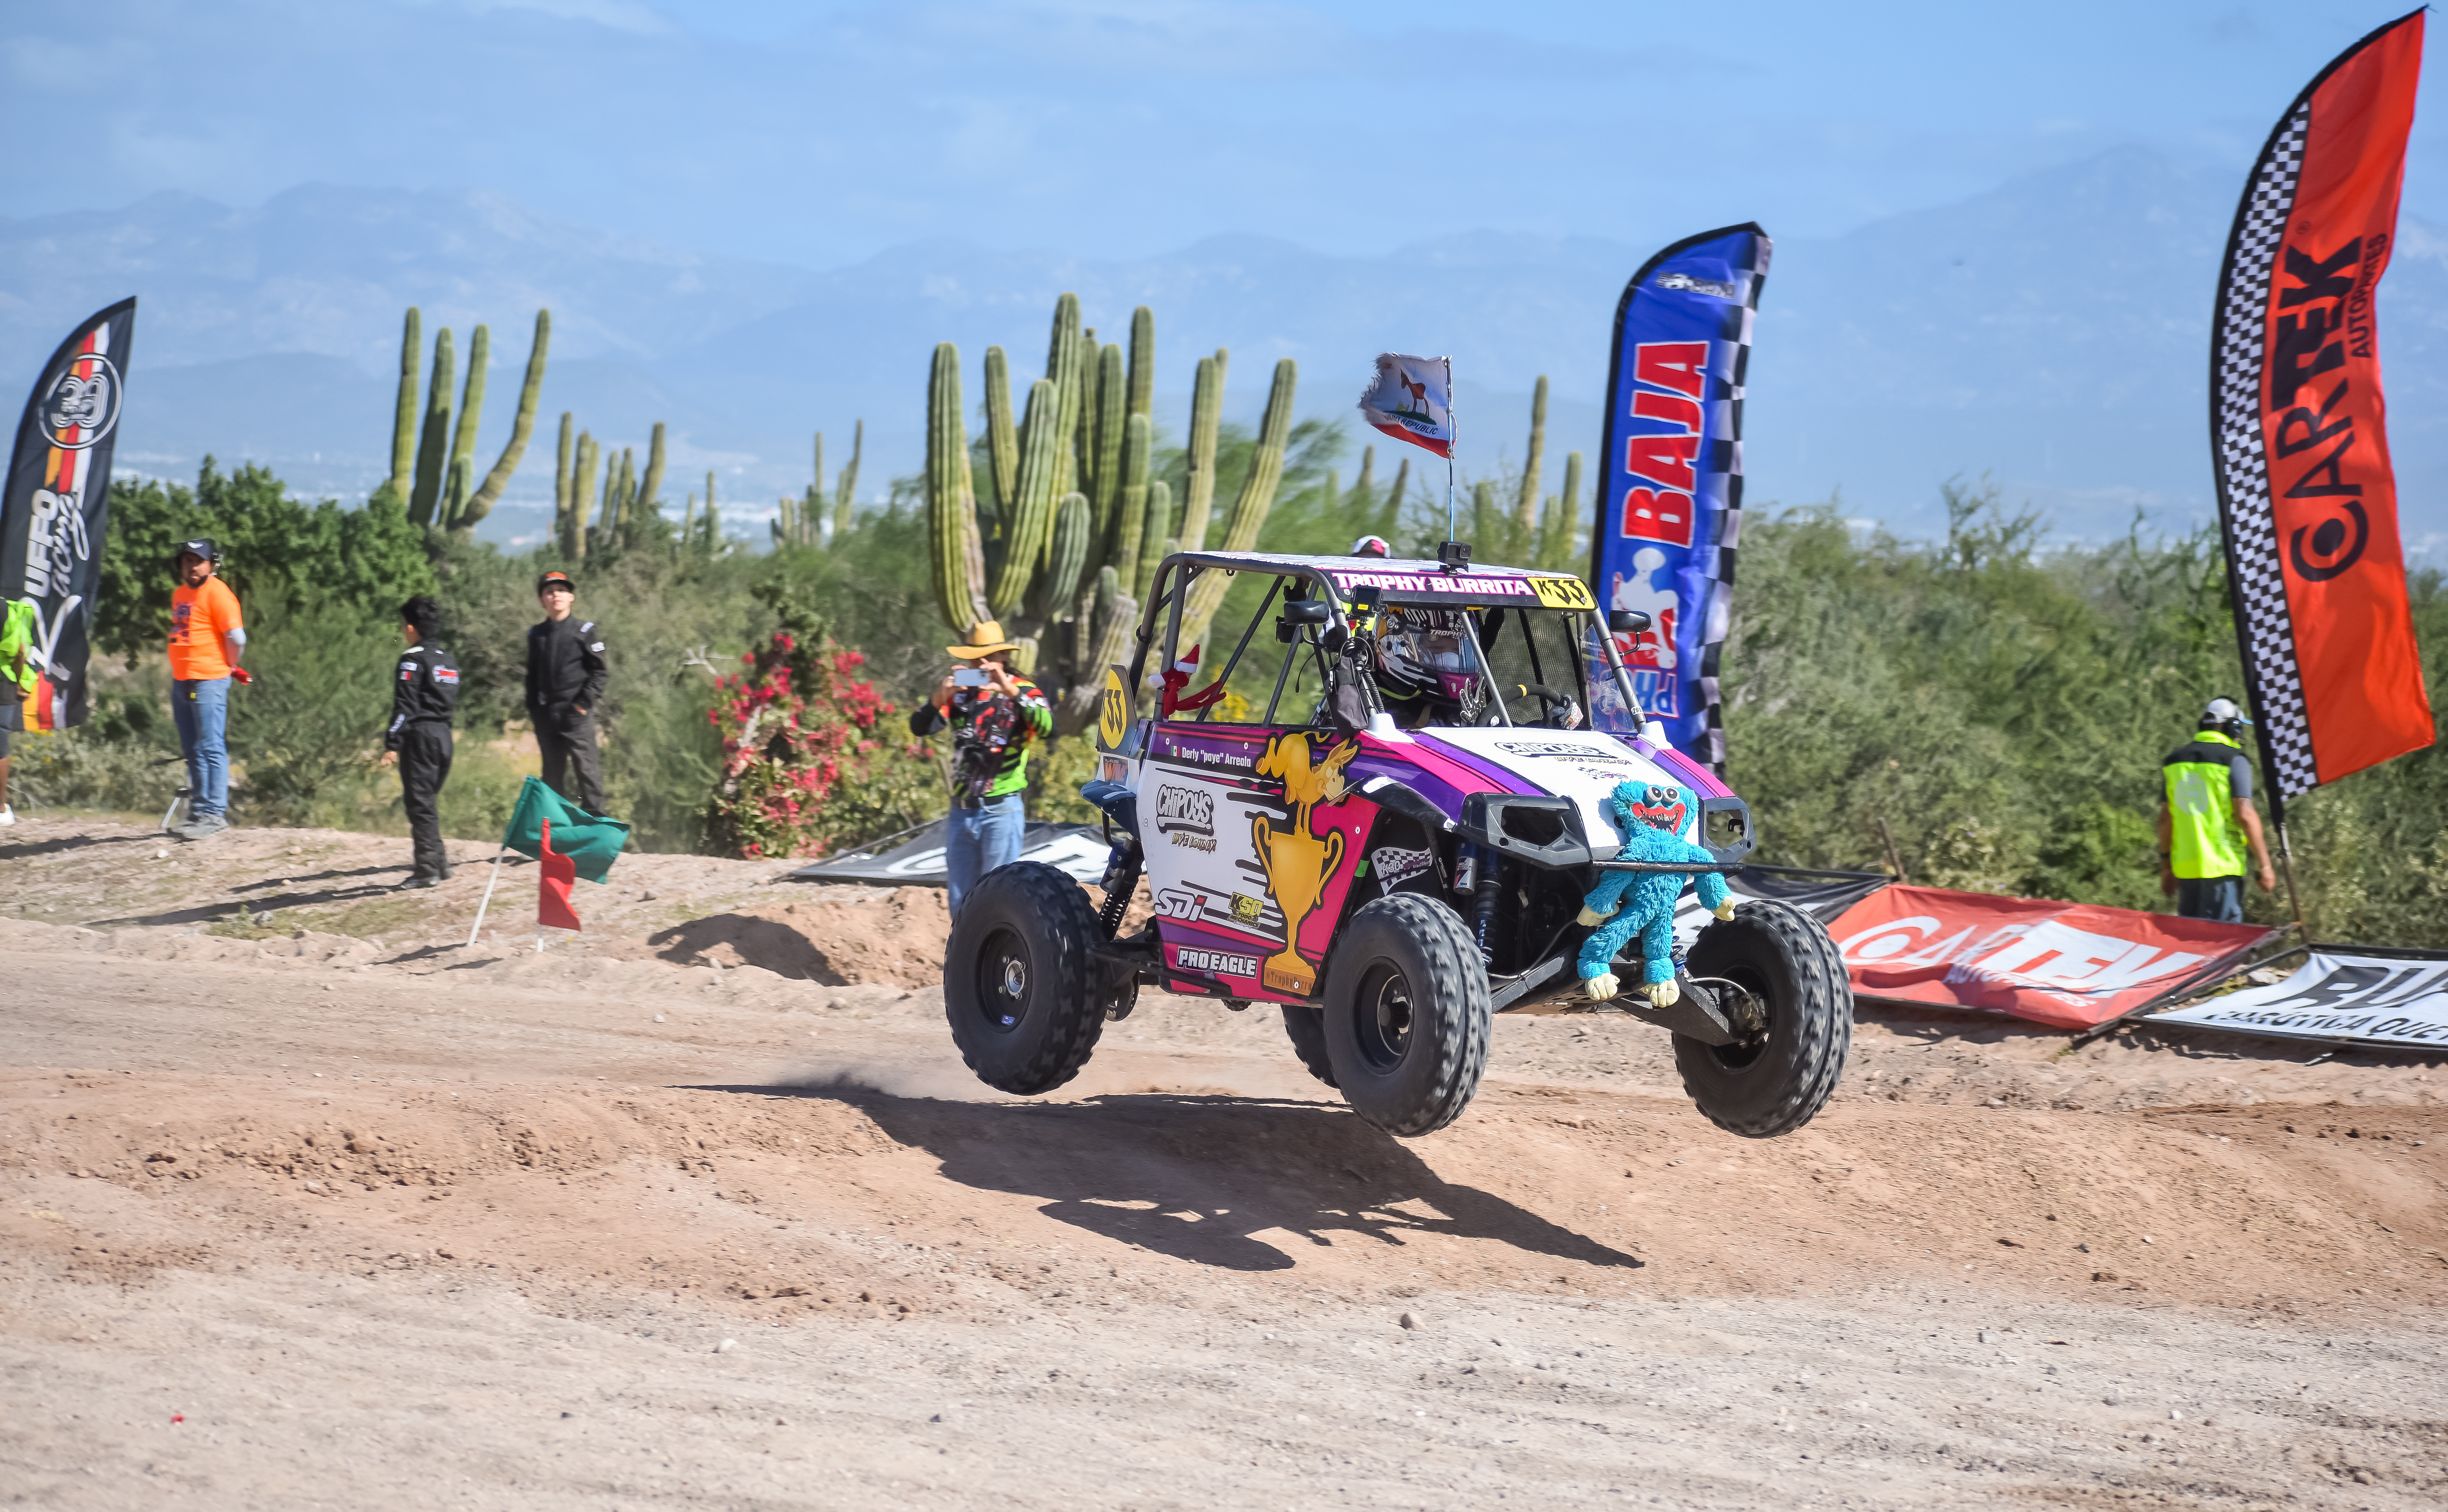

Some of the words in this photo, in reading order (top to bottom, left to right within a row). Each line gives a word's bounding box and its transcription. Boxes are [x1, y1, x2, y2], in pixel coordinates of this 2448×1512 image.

[2270, 235, 2368, 582] CARTEK
[1401, 417, 1439, 435] REPUBLIC
[1621, 341, 1711, 549] BAJA
[1332, 572, 1429, 591] TROPHY
[1428, 577, 1537, 597] BURRITA
[1430, 629, 1465, 637] TROPHY
[1625, 667, 1680, 719] PR
[1182, 746, 1199, 762] Derly
[1224, 753, 1251, 768] Arreola
[1171, 832, 1190, 847] LIVE
[1237, 912, 1253, 920] TODO
[1178, 950, 1209, 968] PRO
[1210, 954, 1256, 976] EAGLE
